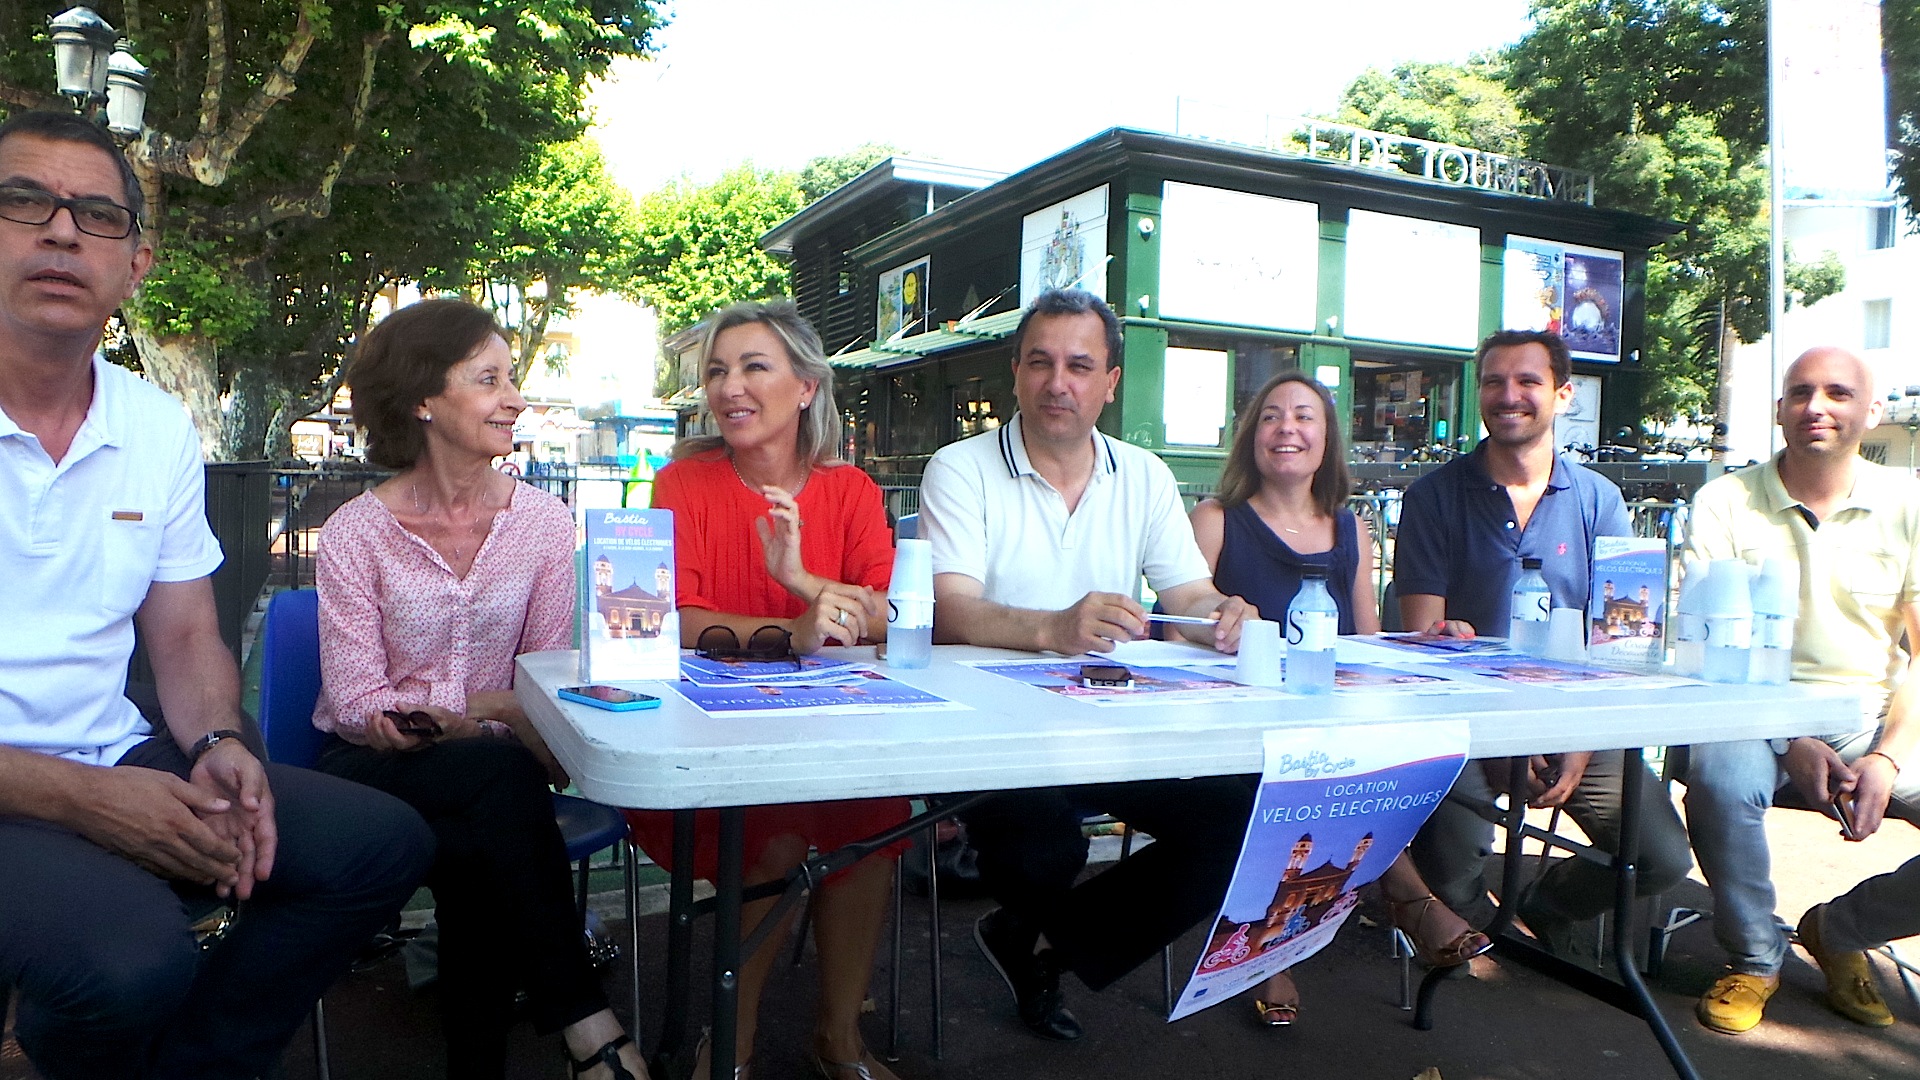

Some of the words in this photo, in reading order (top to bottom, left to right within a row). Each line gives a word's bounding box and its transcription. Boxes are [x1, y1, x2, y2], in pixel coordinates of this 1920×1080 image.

[1350, 131, 1399, 171] DE
[604, 512, 649, 525] Bastia
[593, 537, 617, 545] LOCATION
[616, 526, 626, 537] BY
[628, 526, 654, 538] CYCLE
[1287, 609, 1304, 645] S
[1279, 750, 1330, 775] Bastia
[1322, 757, 1356, 774] Cycle
[1325, 780, 1399, 798] LOCATION
[1263, 804, 1323, 824] VELOS
[1328, 789, 1442, 818] ELECTRIQUES
